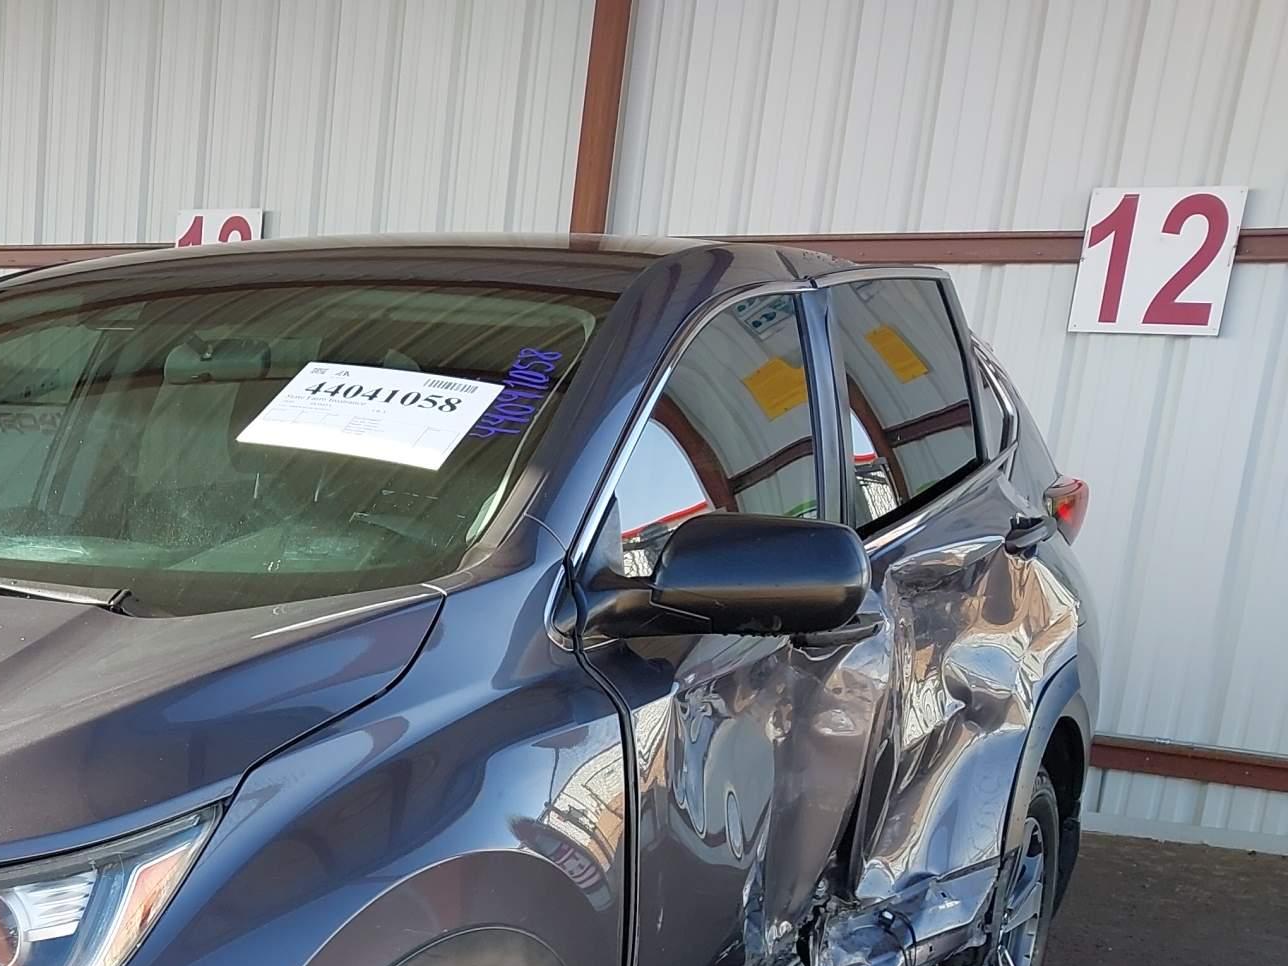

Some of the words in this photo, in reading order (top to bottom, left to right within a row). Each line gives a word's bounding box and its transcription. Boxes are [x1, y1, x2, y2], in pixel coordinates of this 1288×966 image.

[1087, 193, 1230, 326] 12
[304, 381, 462, 413] 44041058
[468, 346, 564, 439] 44041058
